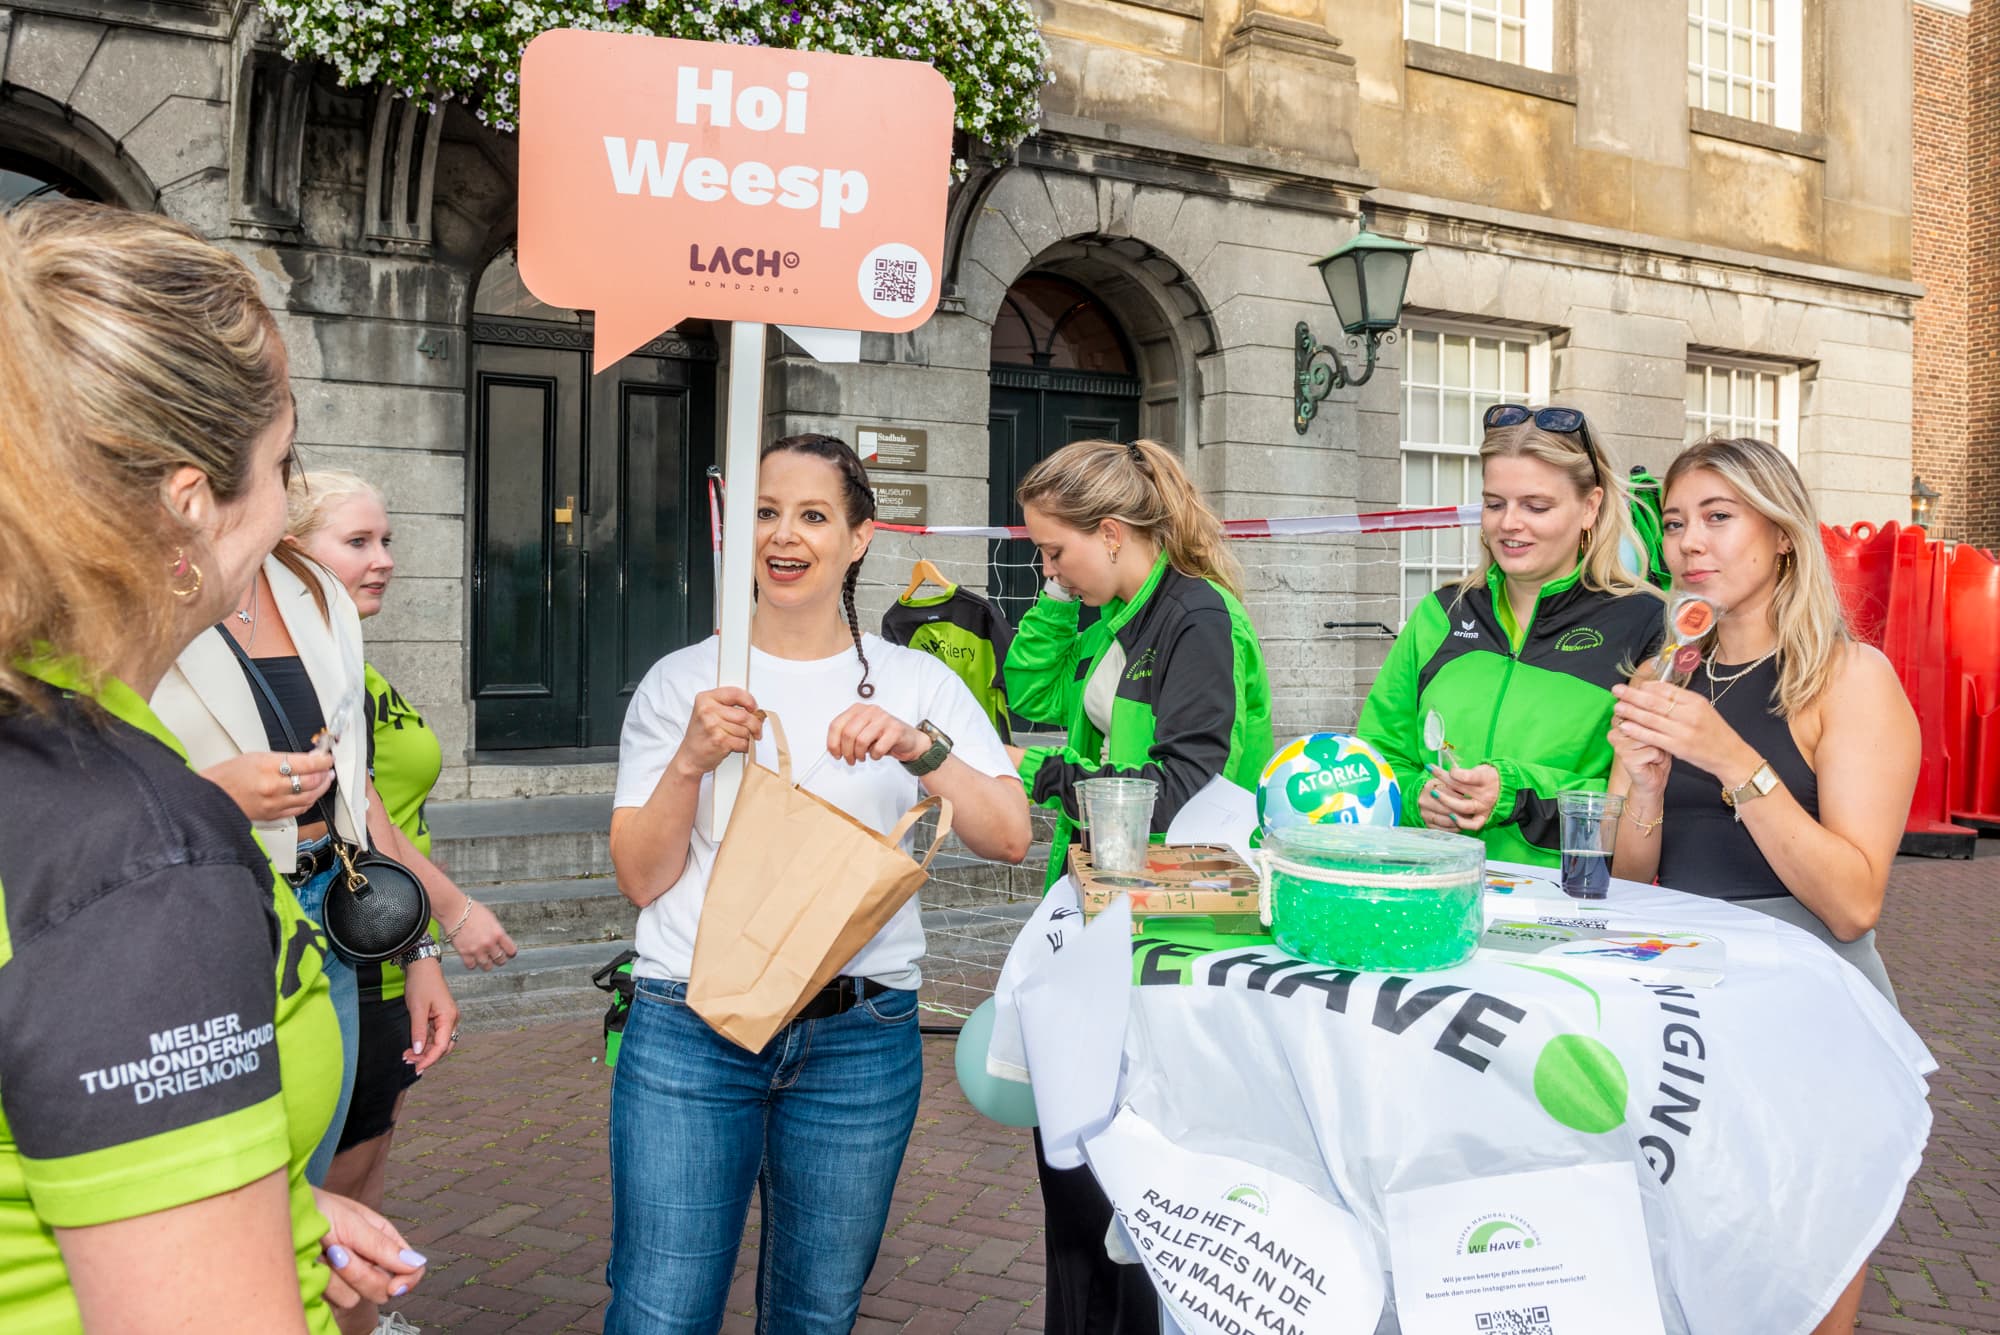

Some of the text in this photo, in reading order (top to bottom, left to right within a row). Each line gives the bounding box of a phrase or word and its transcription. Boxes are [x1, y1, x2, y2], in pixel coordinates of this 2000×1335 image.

[675, 65, 809, 134] Hoi
[602, 136, 869, 229] Weesp
[689, 280, 799, 294] MONDZORG
[877, 433, 907, 442] Stadhuis
[1453, 630, 1479, 639] erima
[1298, 762, 1370, 796] ATORKA
[149, 1012, 242, 1055] MEIJER
[1207, 952, 1527, 1074] HAVE
[79, 1022, 275, 1095] TUINONDERHOUD
[134, 1050, 260, 1105] DRIEMOND
[1134, 1208, 1312, 1317] BALLETJES IN DE
[1142, 1189, 1199, 1221] RAAD
[1200, 1210, 1246, 1237] HET
[1244, 1231, 1328, 1296] AANTAL
[1468, 1239, 1521, 1255] WE HAVE
[1155, 1250, 1187, 1273] EN
[1187, 1262, 1255, 1314] MAAK
[1179, 1289, 1256, 1335] HAND
